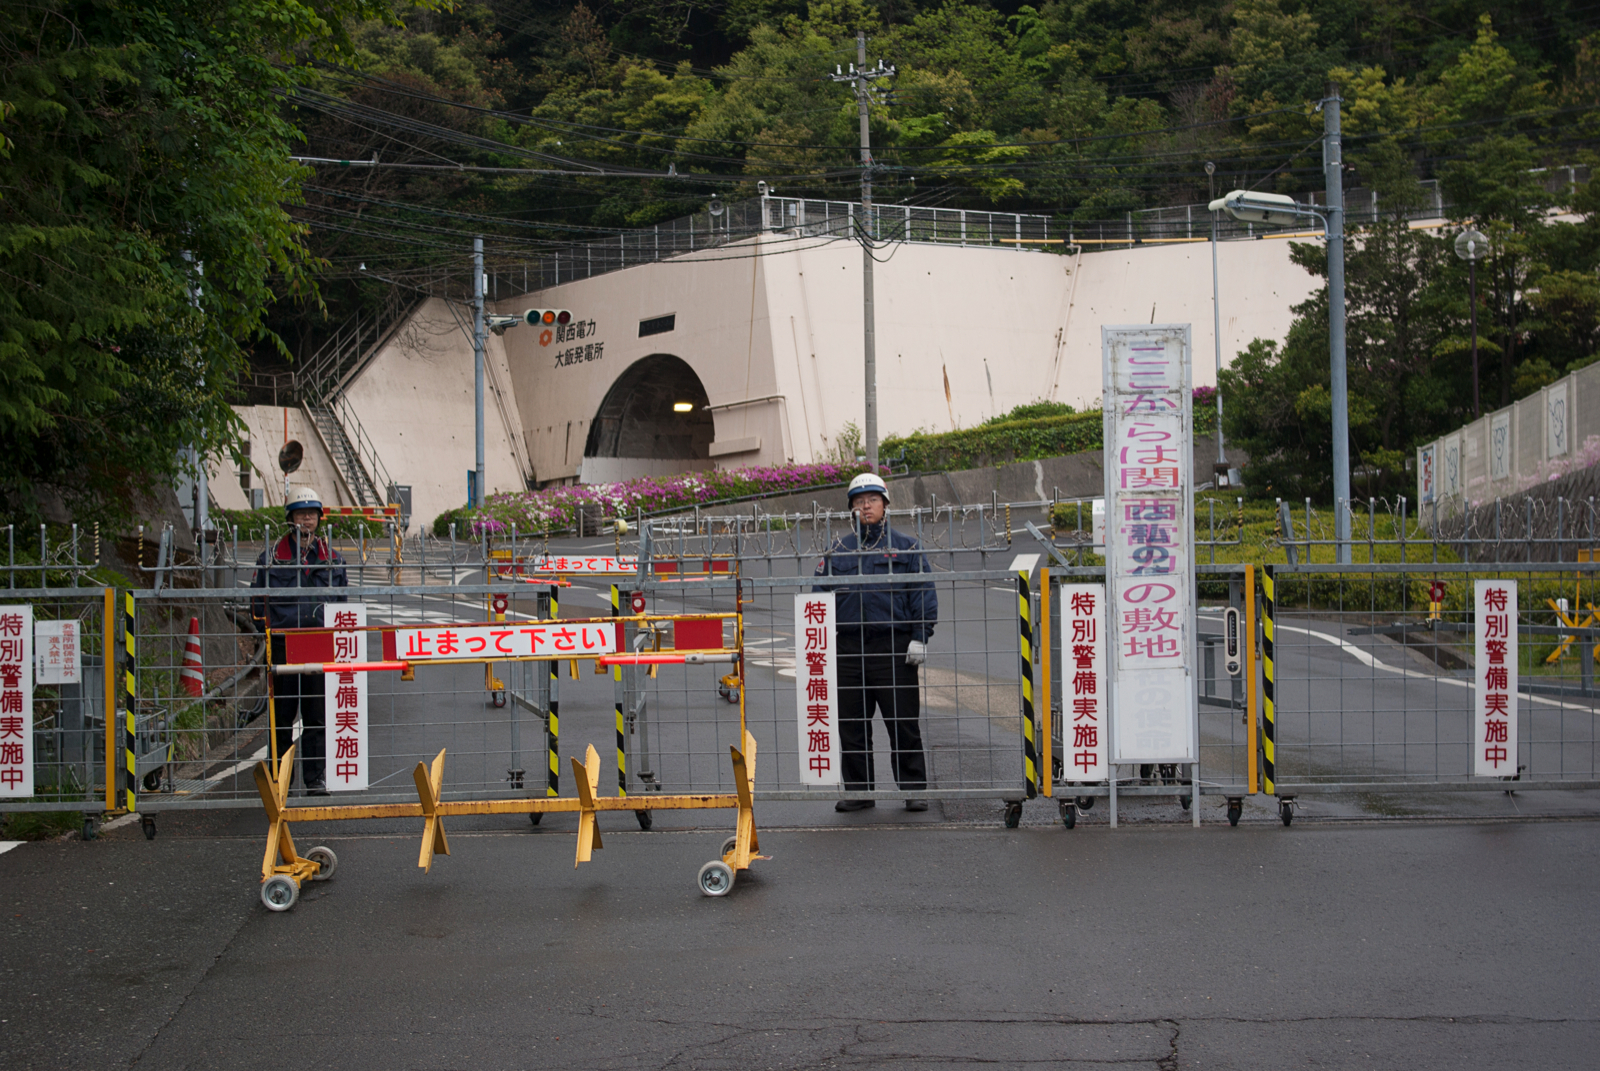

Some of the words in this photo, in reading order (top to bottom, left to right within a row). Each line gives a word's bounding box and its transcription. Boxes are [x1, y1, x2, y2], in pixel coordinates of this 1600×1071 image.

[554, 341, 605, 369] 大飯発電所
[555, 318, 597, 345] 関西電力
[1119, 346, 1182, 659] ここからは関西電力の敷地
[0, 612, 24, 791] 特別警備実施中
[405, 626, 608, 657] 止まって下さい
[804, 600, 831, 778] 特別警備実施中
[1070, 591, 1098, 774] 特別警備実施中
[1484, 587, 1509, 769] 特別警備実施中
